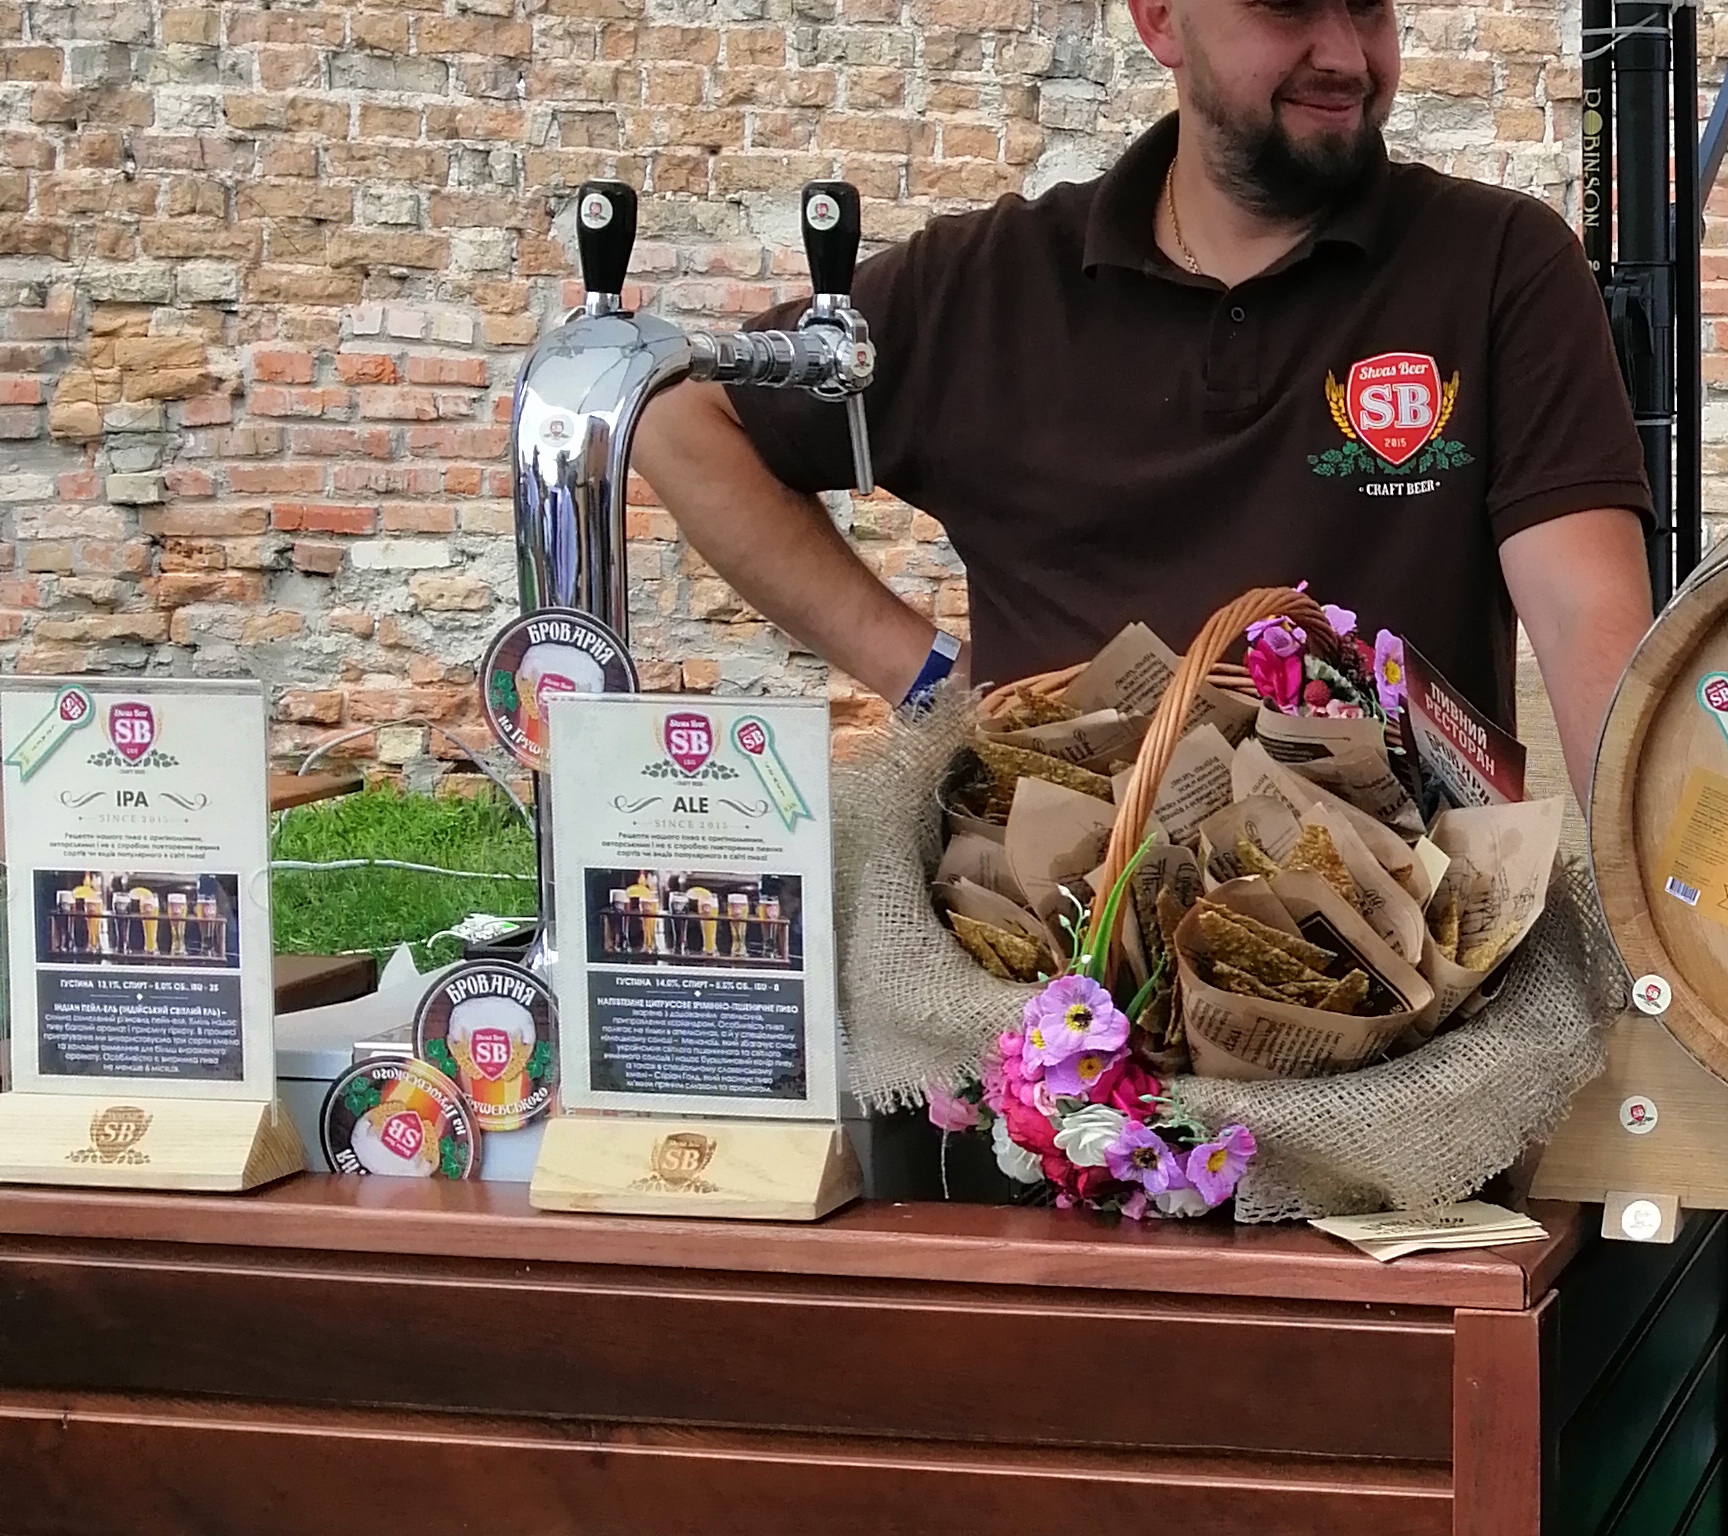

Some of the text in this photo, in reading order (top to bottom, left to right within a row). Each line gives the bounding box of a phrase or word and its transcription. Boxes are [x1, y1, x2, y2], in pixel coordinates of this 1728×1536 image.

[1359, 361, 1428, 380] Shvas Beer
[1360, 382, 1432, 430] SB
[1384, 437, 1407, 448] 2015
[1366, 479, 1435, 496] CRAFT BEER
[526, 619, 615, 665] БРОВАРНЯ
[1430, 681, 1488, 750] ПИВНИЙ
[114, 718, 151, 745] SB
[669, 729, 710, 756] SB
[742, 728, 765, 749] SB
[1424, 692, 1495, 777] РЕСТОРАН
[116, 790, 149, 808] IPA
[672, 796, 709, 814] ALE
[99, 814, 137, 823] SINCE
[654, 818, 694, 829] SINCE
[445, 973, 537, 1007] БРОВАРНЯ
[476, 1042, 508, 1064] SB
[662, 1148, 700, 1172] SB
